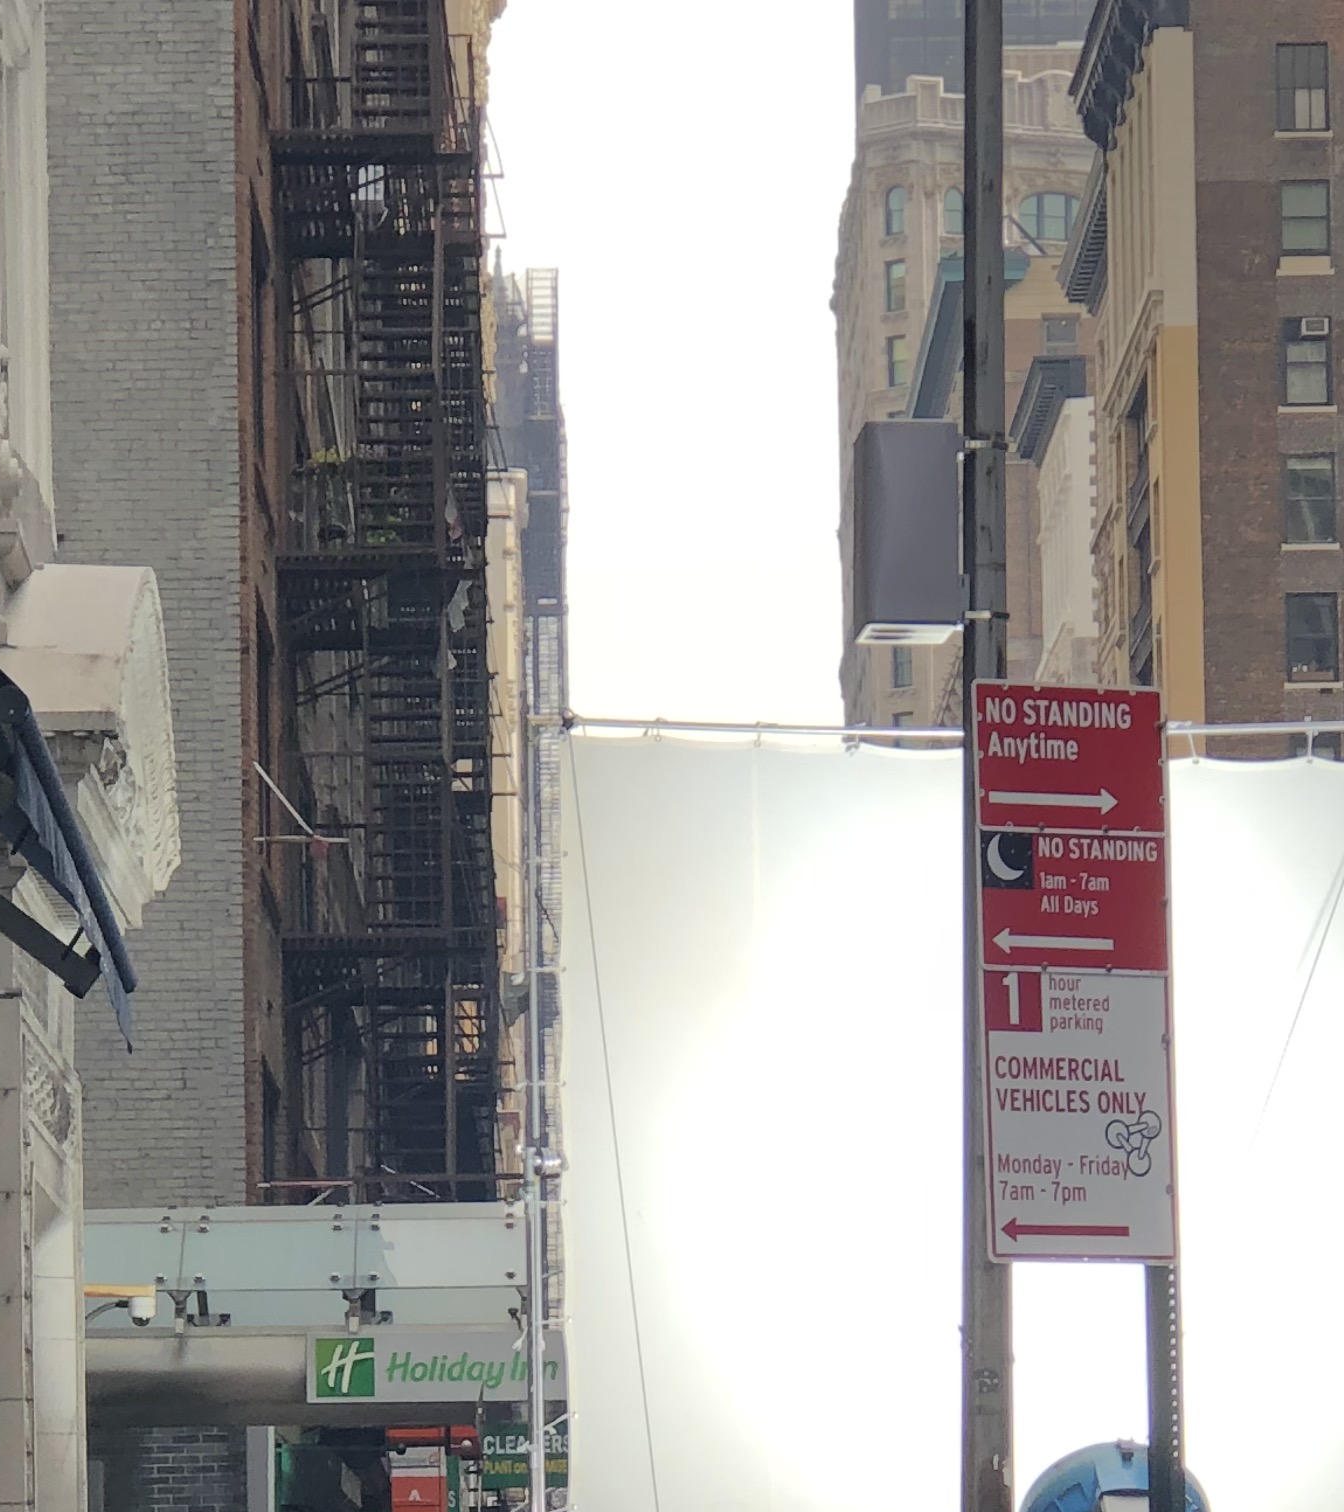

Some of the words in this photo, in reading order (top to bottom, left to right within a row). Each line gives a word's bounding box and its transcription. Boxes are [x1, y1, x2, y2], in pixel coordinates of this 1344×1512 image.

[985, 697, 1016, 723] NO
[1023, 699, 1132, 729] STANDING
[988, 731, 1079, 764] Anytime
[1038, 837, 1064, 858] NO
[1069, 838, 1158, 862] STANDING
[1040, 872, 1067, 890] 1am
[1080, 873, 1110, 891] 7am
[1041, 896, 1059, 914] All
[1064, 896, 1099, 918] Days
[1049, 976, 1081, 992] hour
[1002, 972, 1020, 1025] 1
[1049, 996, 1110, 1012] metered
[1050, 1015, 1103, 1034] parking
[995, 1055, 1125, 1082] COMMERCIAL
[996, 1088, 1090, 1113] VEHICLES
[1098, 1091, 1146, 1115] ONLY
[998, 1154, 1061, 1179] Monday
[1080, 1155, 1131, 1180] Friday
[999, 1181, 1034, 1200] 7am
[1051, 1181, 1086, 1205] 7pm
[386, 1351, 504, 1389] Holiday
